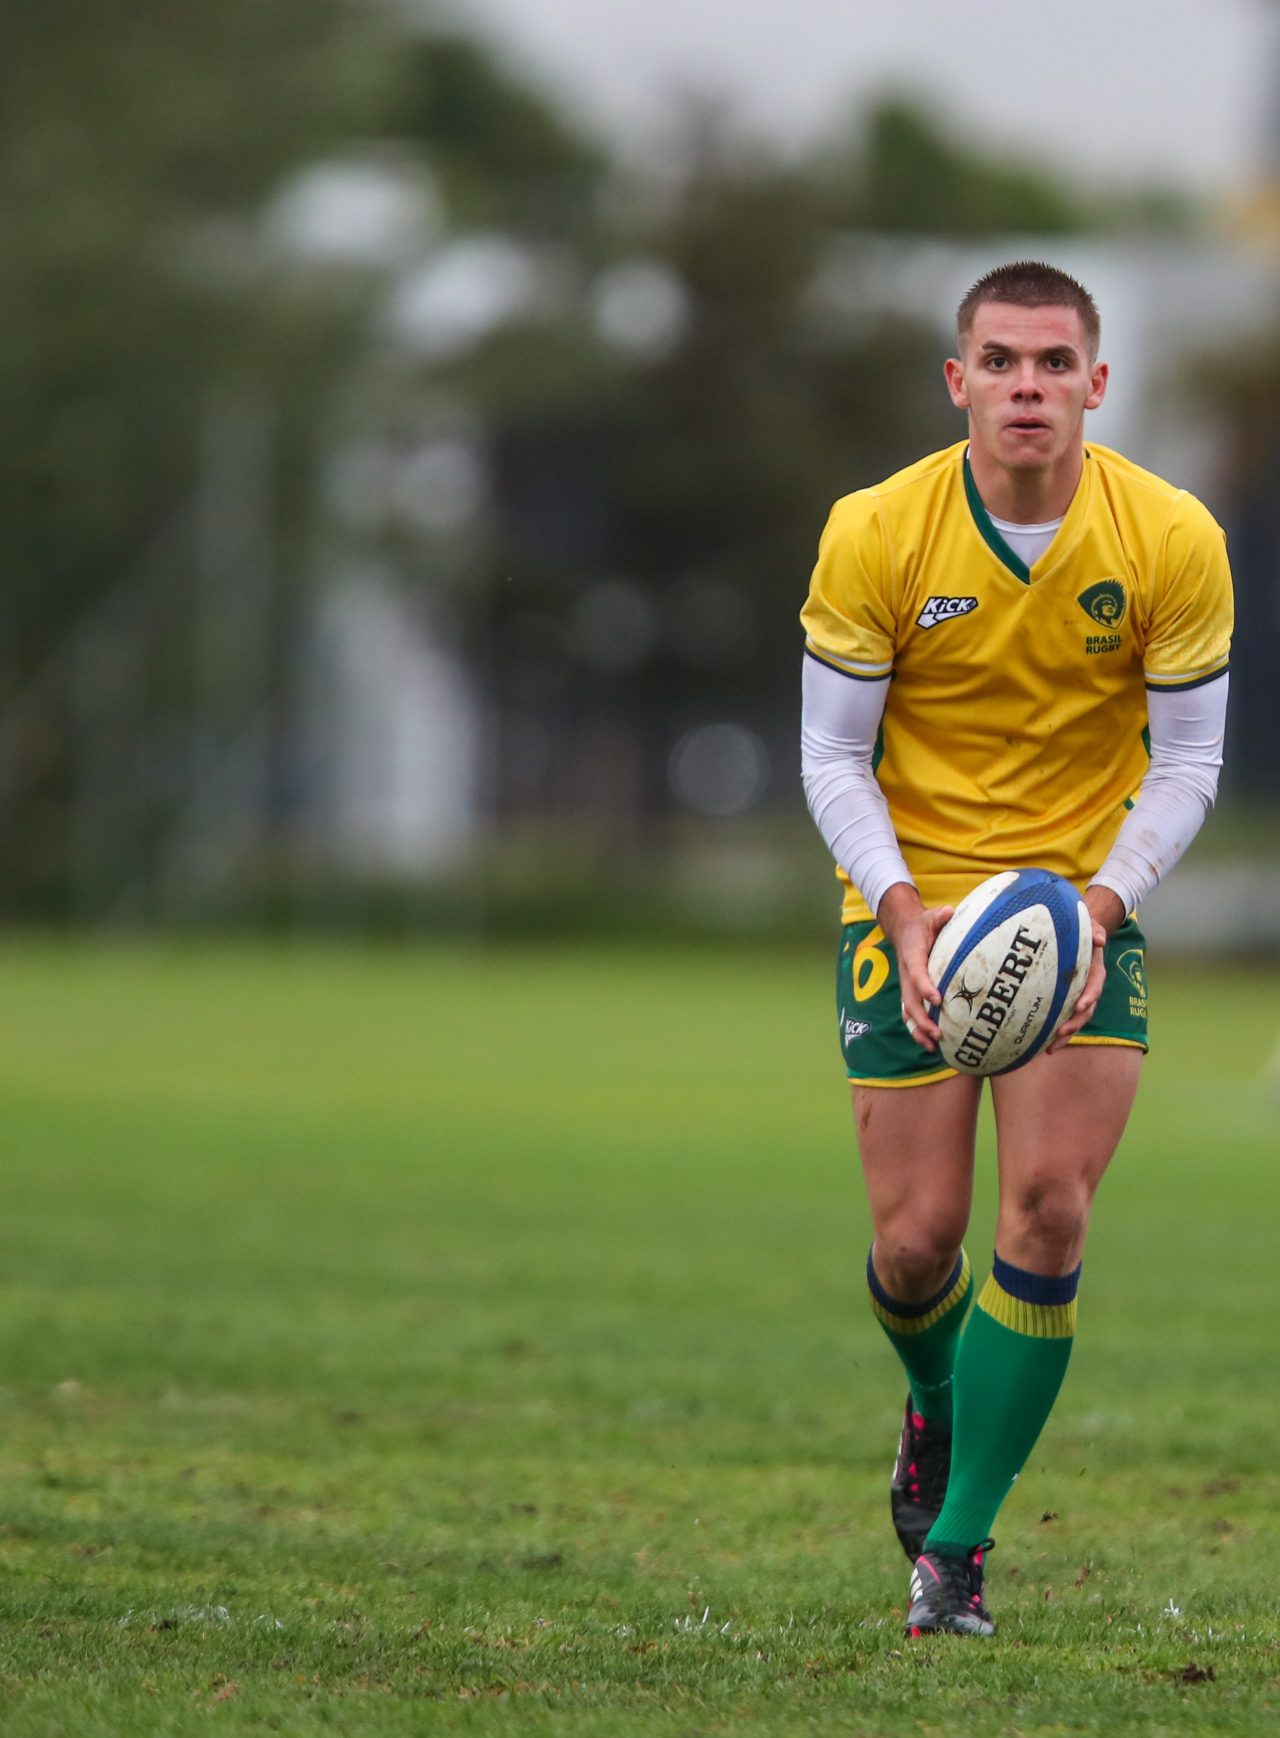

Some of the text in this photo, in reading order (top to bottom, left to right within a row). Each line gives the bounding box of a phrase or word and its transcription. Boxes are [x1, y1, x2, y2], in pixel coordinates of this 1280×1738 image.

[1086, 634, 1122, 645] BRASIL
[1086, 644, 1121, 655] RUGBY
[853, 924, 890, 1002] 6
[954, 924, 1042, 1068] GILBERT
[1014, 996, 1044, 1045] QUANTUM
